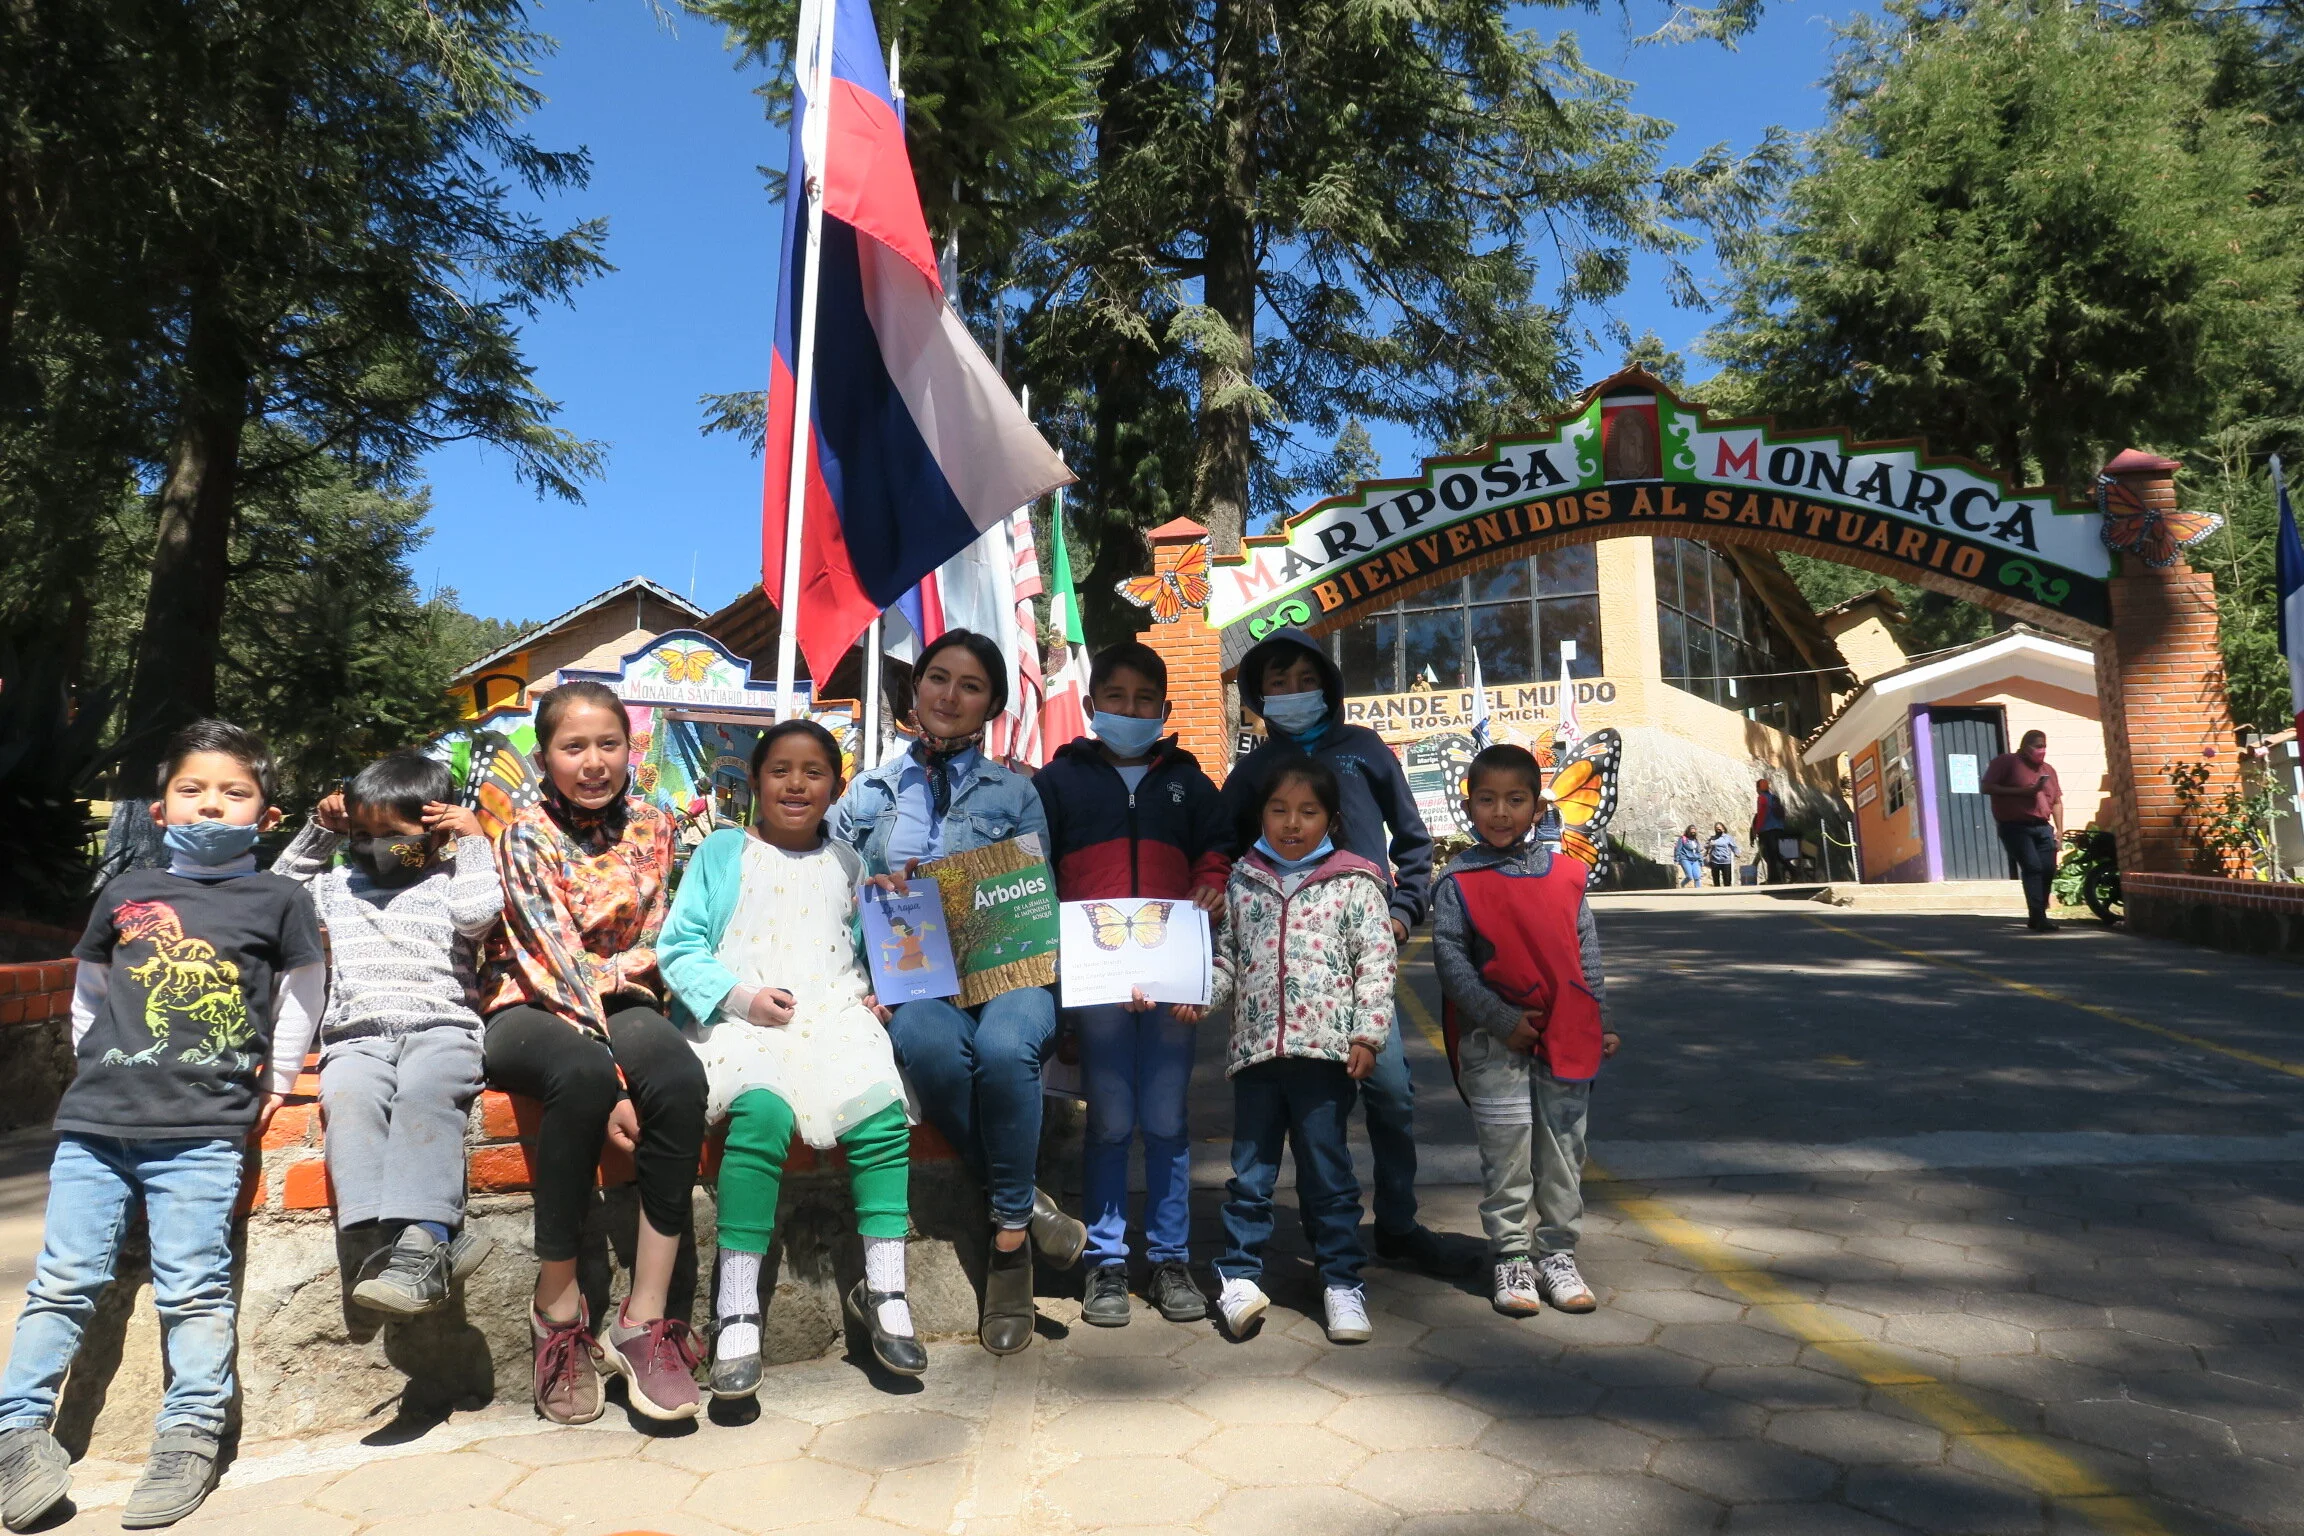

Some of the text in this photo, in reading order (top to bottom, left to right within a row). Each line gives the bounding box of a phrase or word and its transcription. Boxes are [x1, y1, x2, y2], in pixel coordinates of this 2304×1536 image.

[1230, 436, 2040, 603] MARIPOSA MONARCA
[1311, 487, 1986, 613] BIENVENIDOS AL SANTUARIO
[630, 680, 684, 701] MONARCA
[688, 687, 742, 705] SANTUARIO
[1346, 695, 1448, 721] RANDE
[1372, 708, 1549, 732] EL ROSAR MICH.
[974, 877, 1047, 911] Árboles
[1028, 897, 1050, 908] SEMILLA
[897, 902, 921, 915] ropa
[1020, 903, 1051, 917] IMPONENTE
